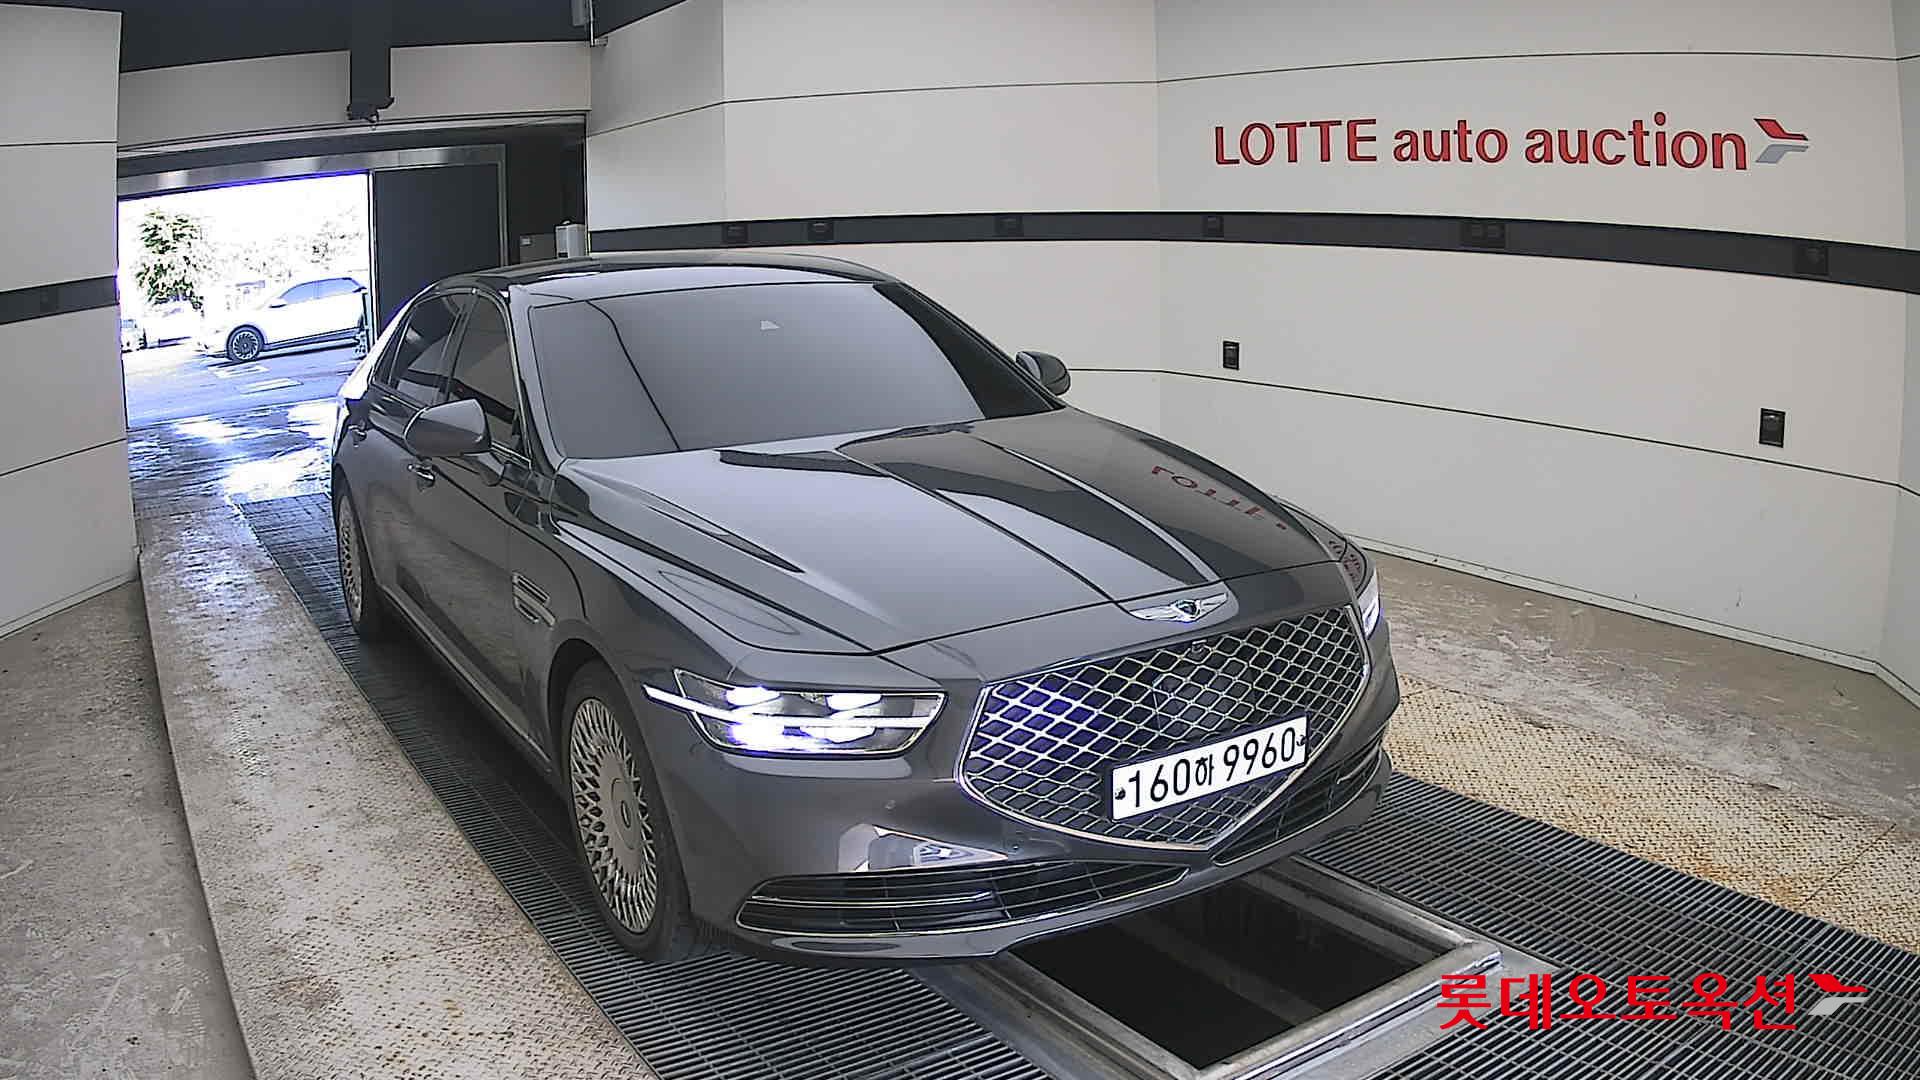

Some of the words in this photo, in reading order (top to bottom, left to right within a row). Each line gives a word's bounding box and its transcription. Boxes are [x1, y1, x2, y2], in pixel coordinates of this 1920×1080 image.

[1214, 118, 1377, 165] LOTTE
[1393, 119, 1508, 164] auto
[1524, 111, 1748, 170] auction
[1127, 753, 1214, 808] 160하
[1223, 727, 1296, 781] 9960
